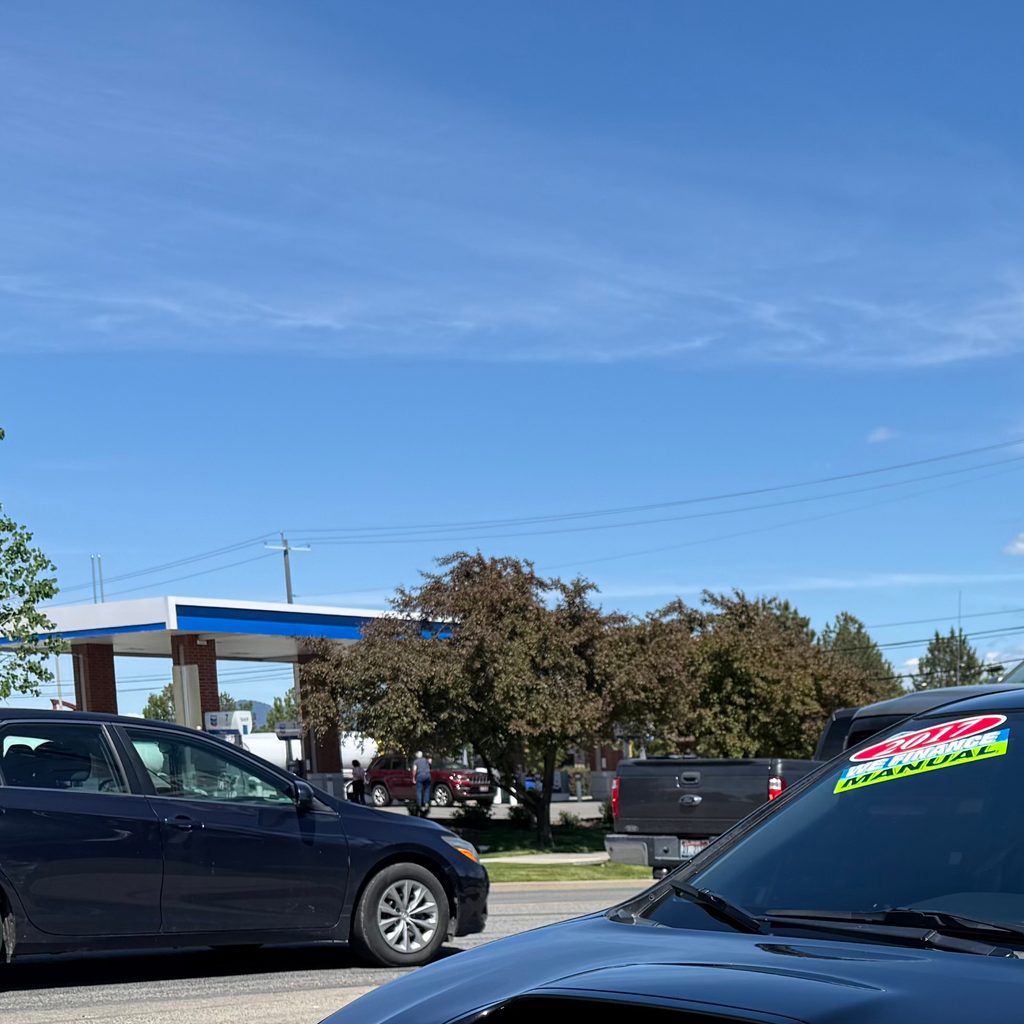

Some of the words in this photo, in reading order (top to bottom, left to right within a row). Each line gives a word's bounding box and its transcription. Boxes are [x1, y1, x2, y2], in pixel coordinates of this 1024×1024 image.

[847, 758, 888, 778] WE
[889, 731, 1000, 766] FINANCE
[874, 718, 983, 760] 2017
[841, 746, 996, 789] MANUAL
